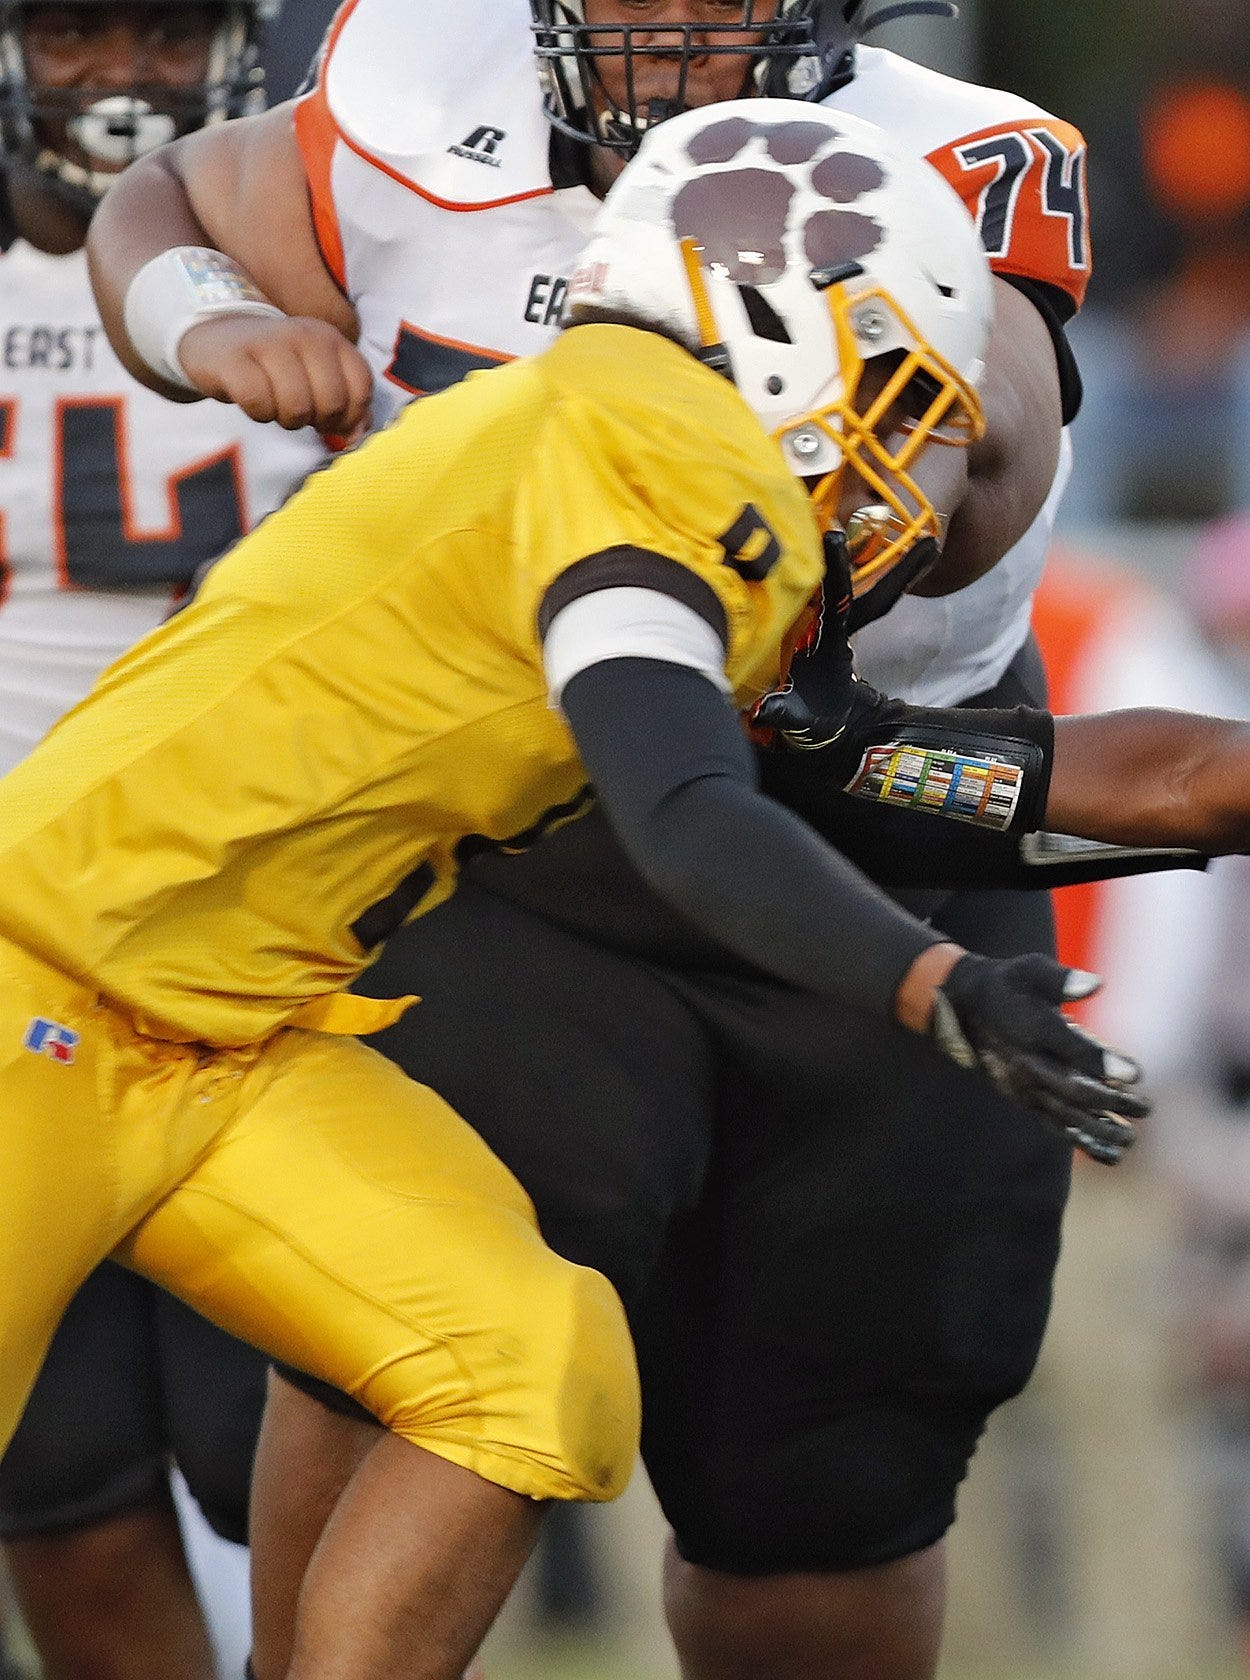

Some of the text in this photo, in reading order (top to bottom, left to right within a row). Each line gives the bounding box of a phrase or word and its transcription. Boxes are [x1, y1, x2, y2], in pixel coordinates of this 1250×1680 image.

[952, 127, 1088, 270] 74
[525, 274, 568, 325] EA
[4, 325, 97, 369] EAST
